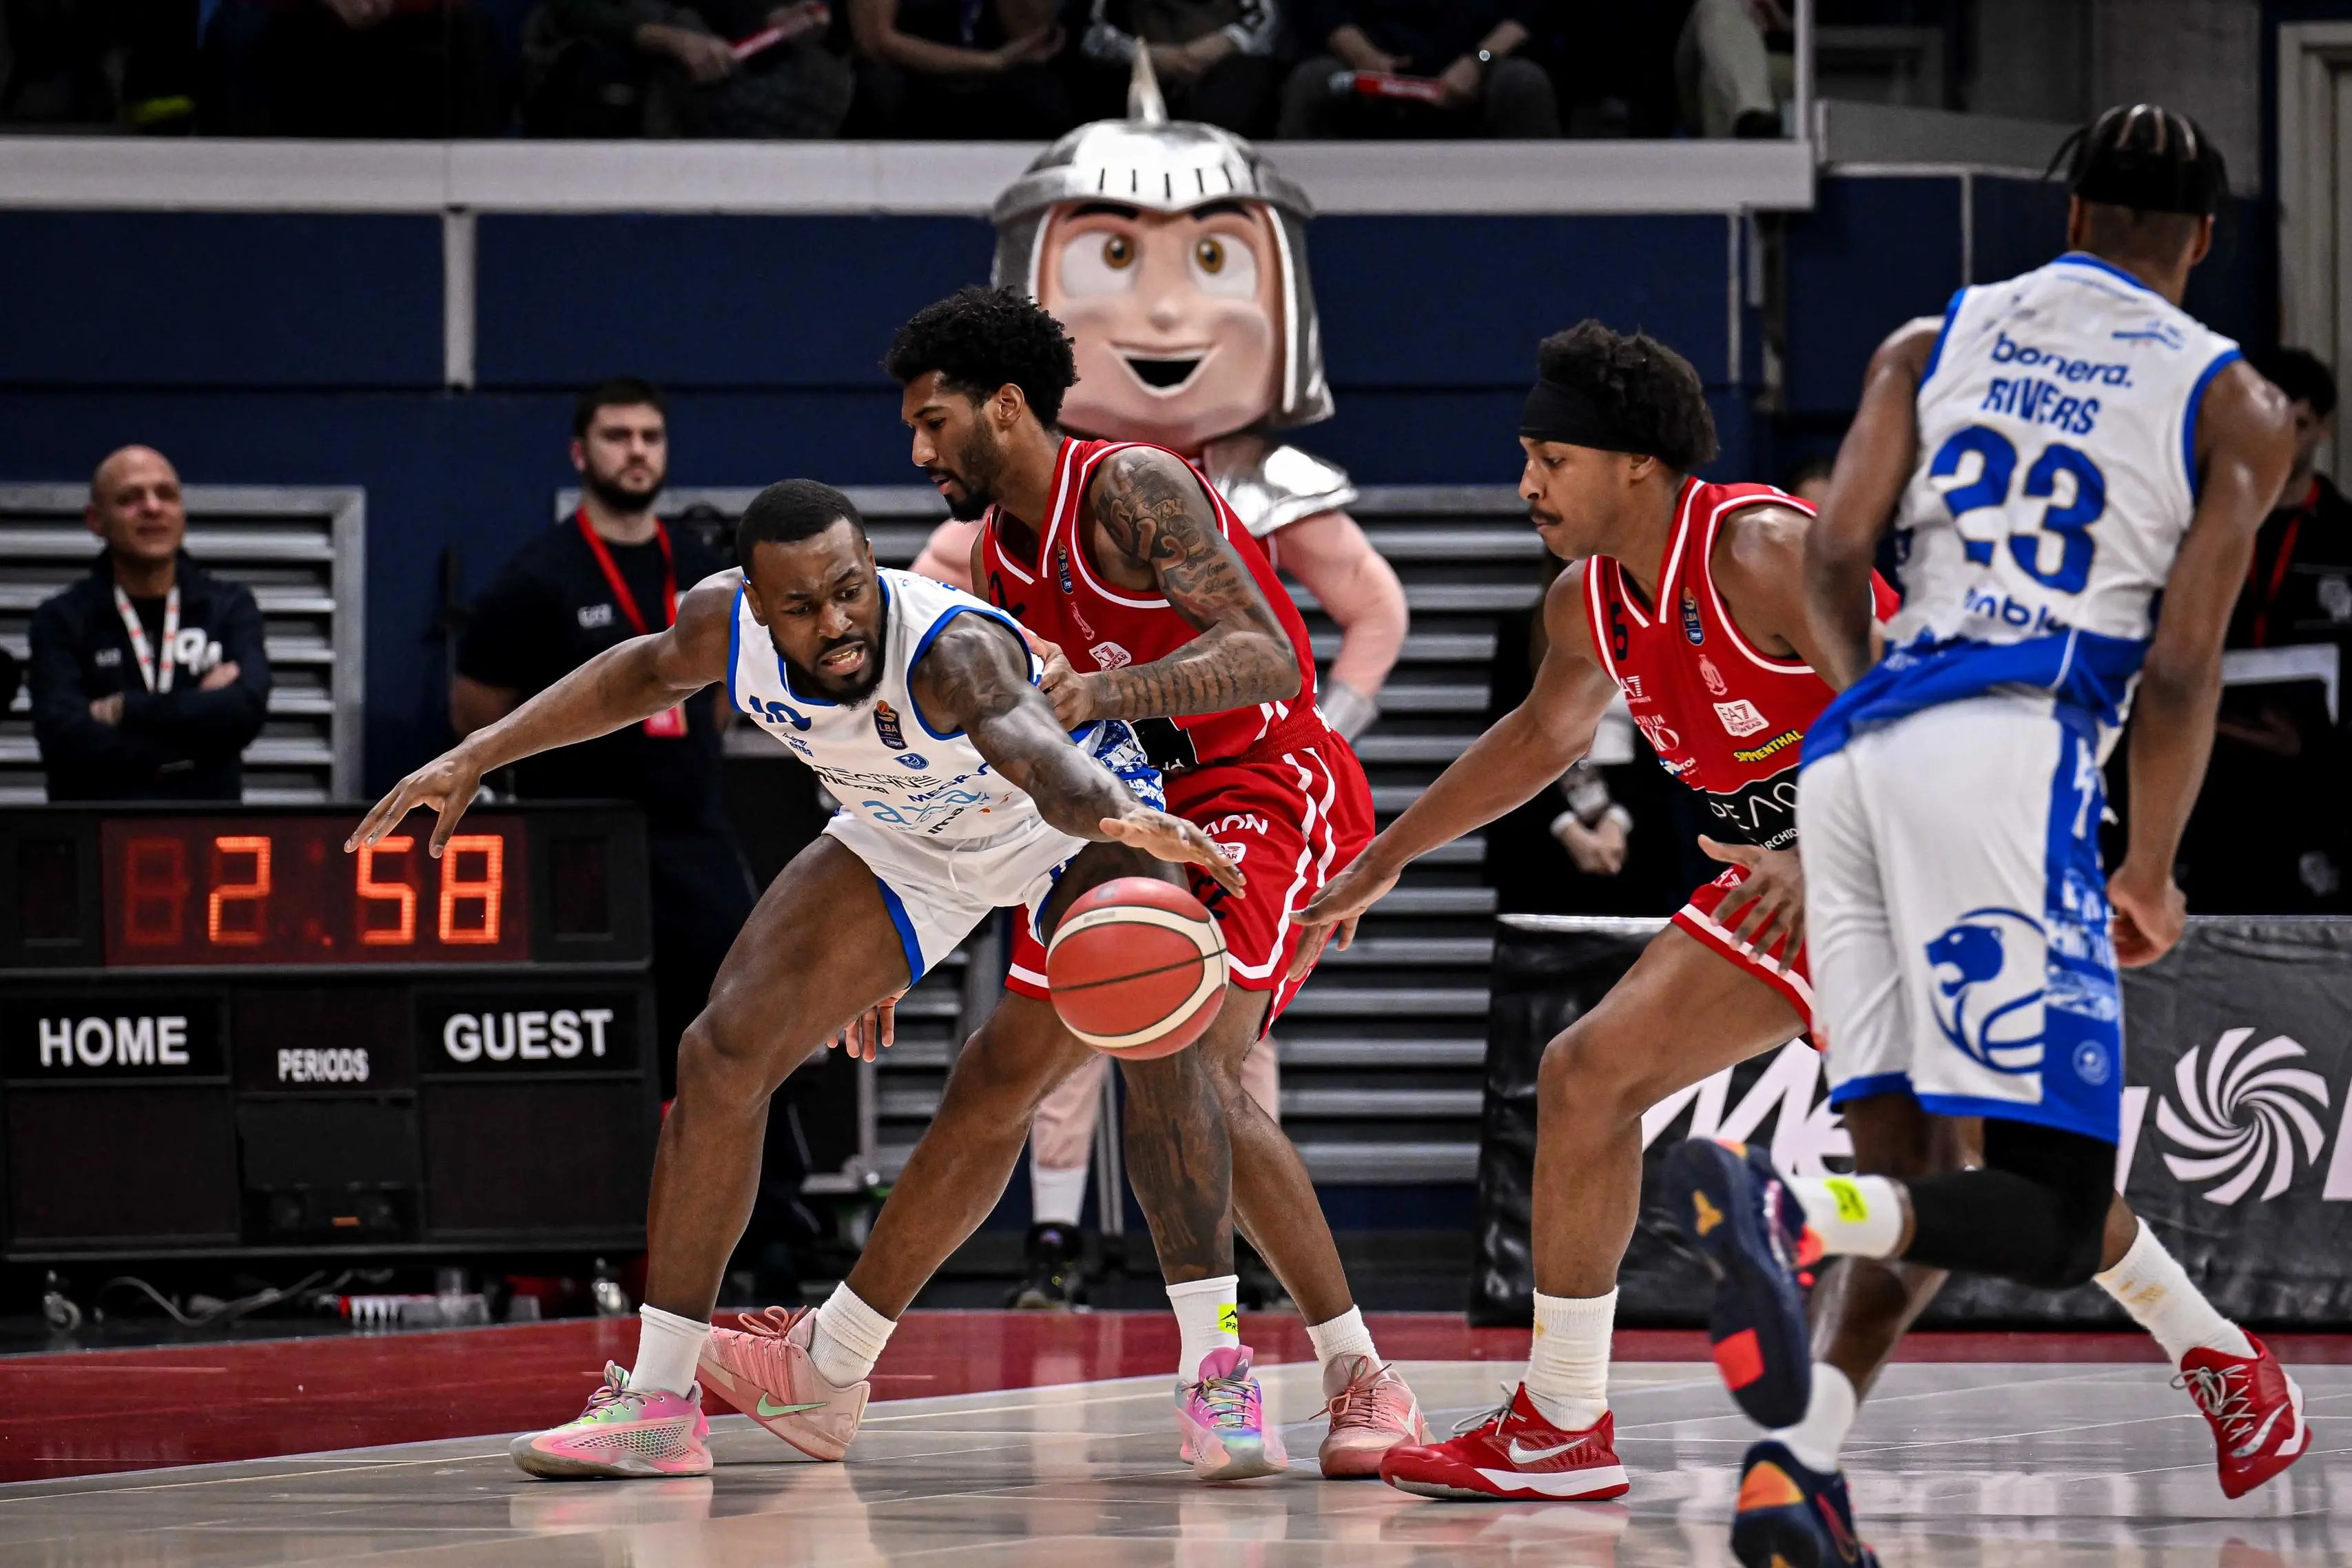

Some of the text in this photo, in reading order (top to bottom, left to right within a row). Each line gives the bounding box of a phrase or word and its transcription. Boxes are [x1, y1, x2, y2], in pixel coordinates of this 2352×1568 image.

[1990, 331, 2133, 388] bonera.
[1981, 377, 2101, 435] RIVERS
[1929, 424, 2106, 595] 23
[878, 723, 898, 733] LBA
[39, 1015, 190, 1067] HOME
[443, 1008, 613, 1063] GUEST
[278, 1047, 370, 1084] PERIODS
